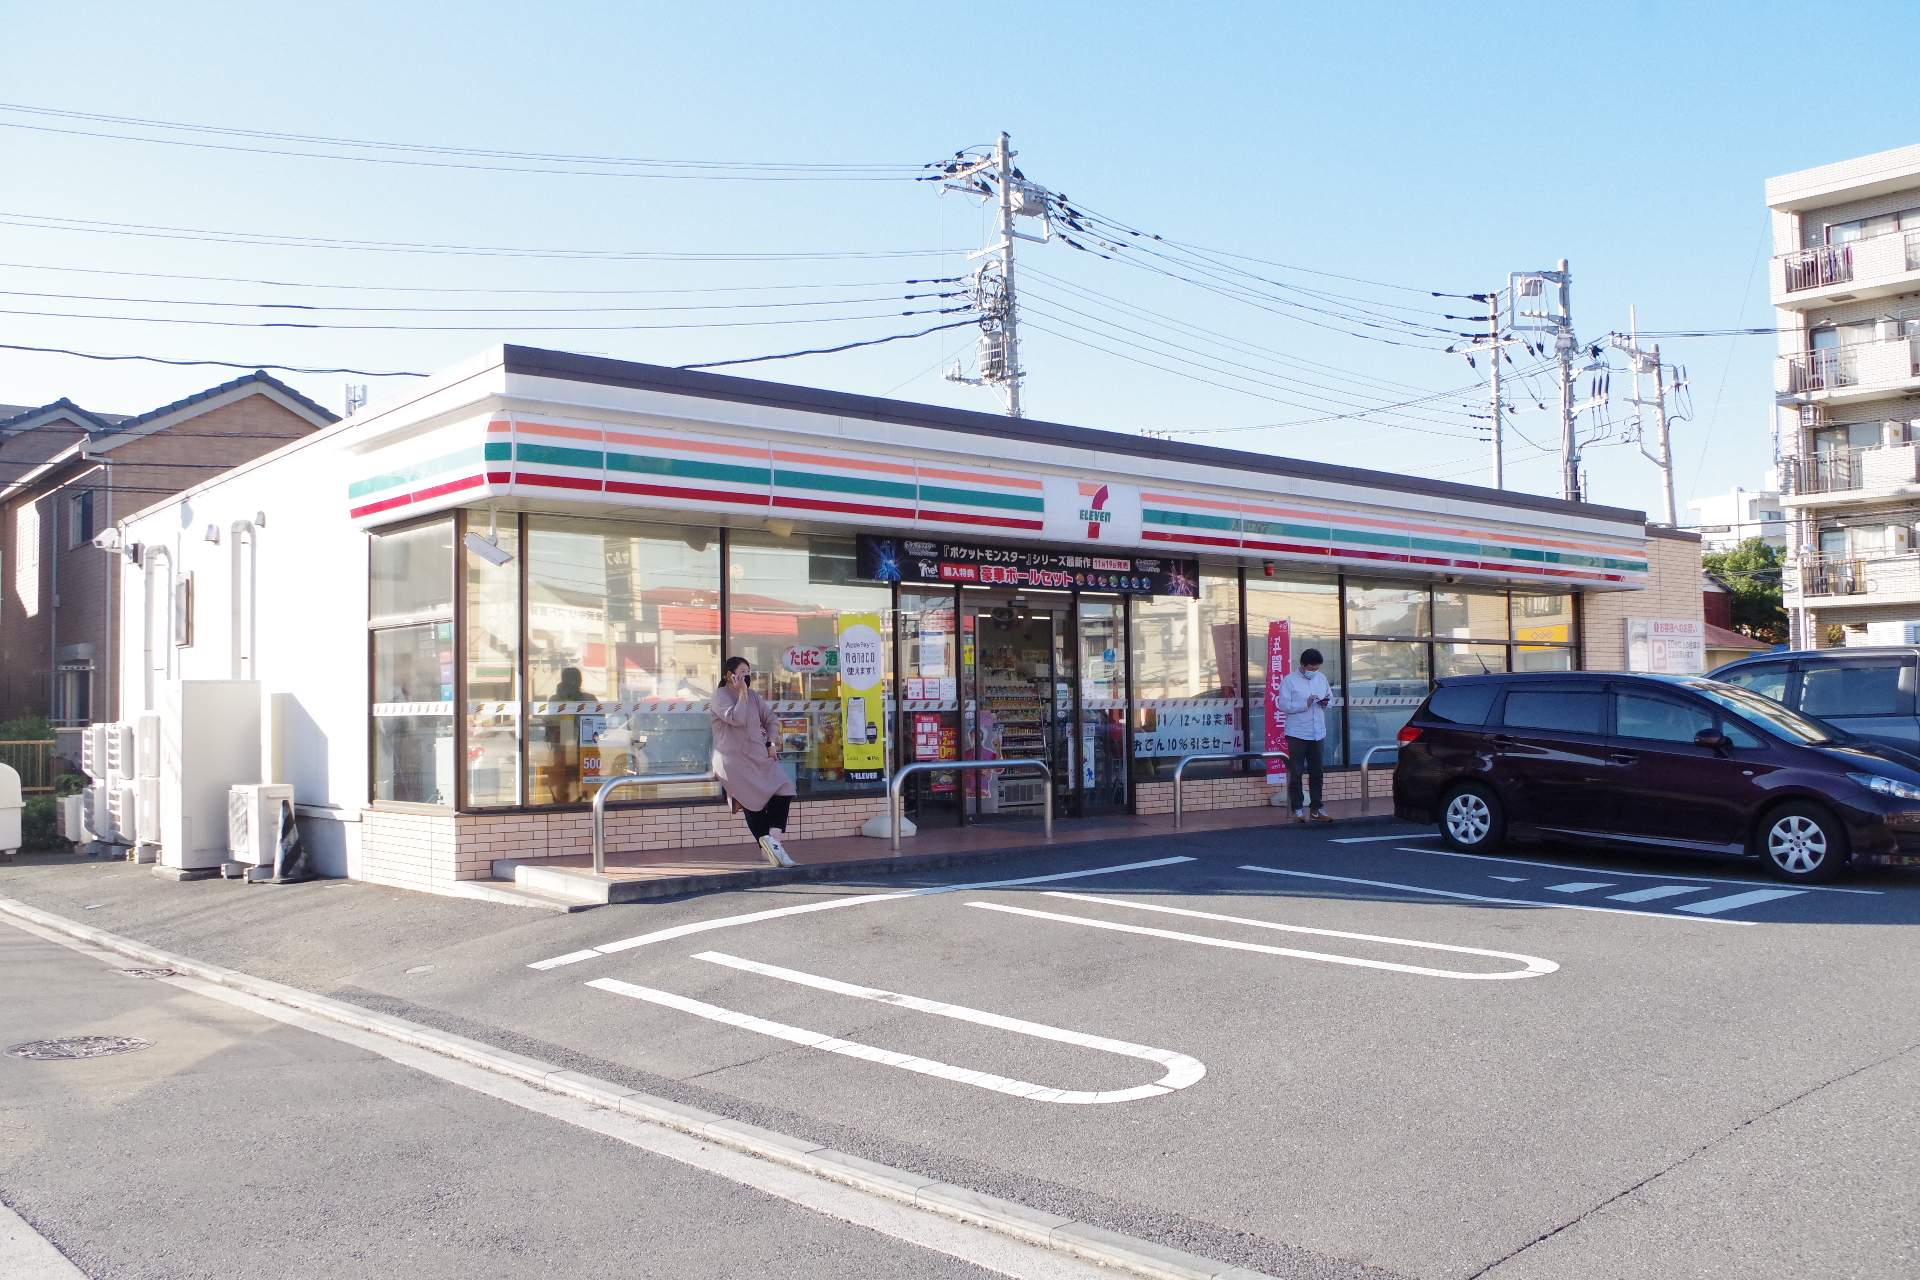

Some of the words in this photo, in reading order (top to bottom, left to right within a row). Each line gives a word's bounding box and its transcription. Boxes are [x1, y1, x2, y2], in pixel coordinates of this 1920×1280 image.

[980, 565, 1073, 587] 豪華ボールセット
[790, 650, 819, 665] たばこ
[825, 650, 838, 666] 酒
[845, 653, 875, 664] nanaco
